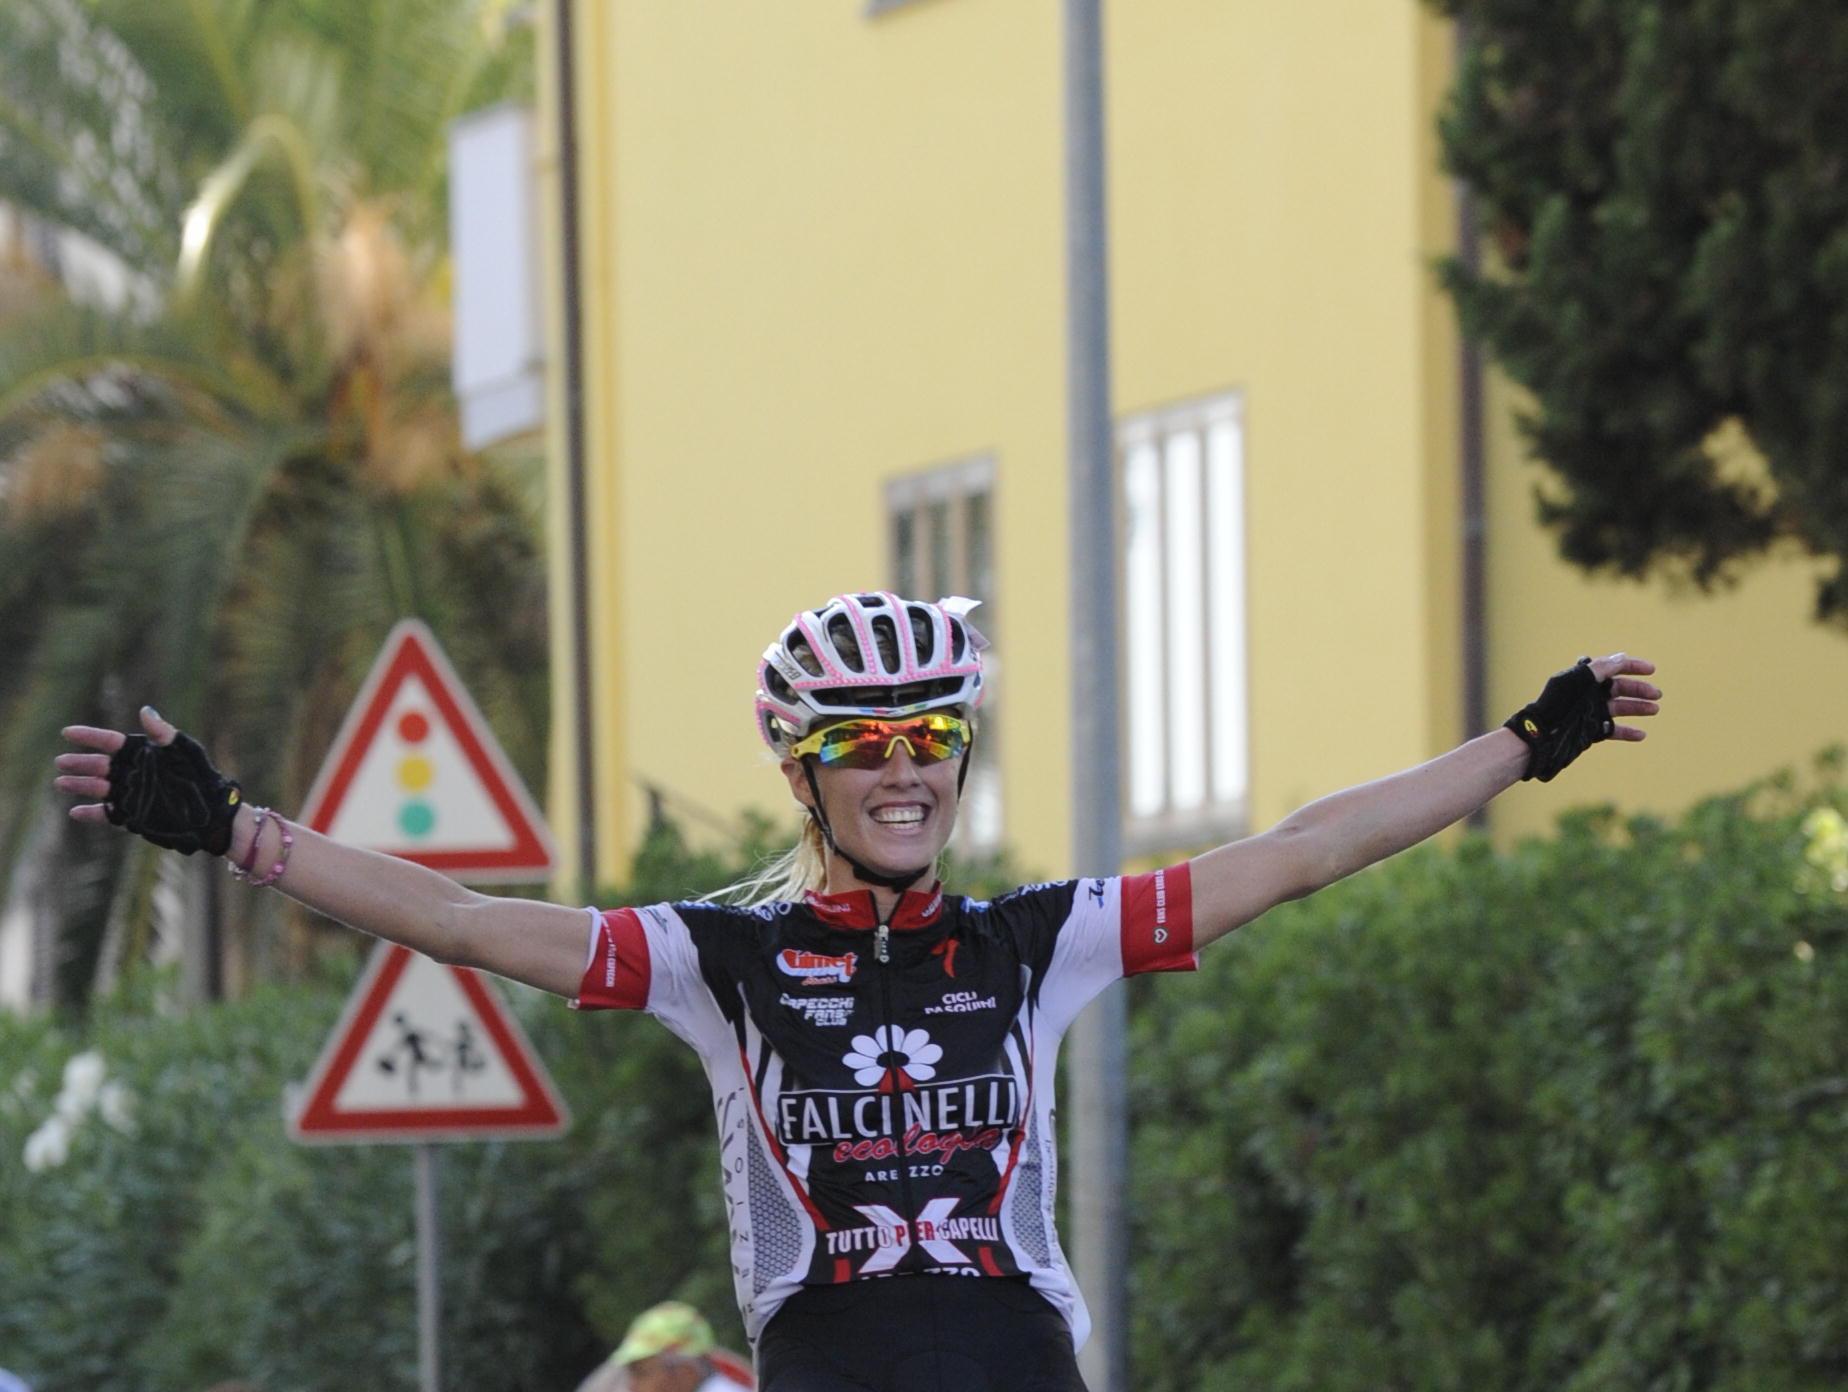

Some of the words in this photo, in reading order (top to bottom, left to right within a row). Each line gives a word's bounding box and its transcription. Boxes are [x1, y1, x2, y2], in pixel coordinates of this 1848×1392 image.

[780, 1081, 1016, 1140] FALCINELLI
[865, 1164, 944, 1182] AREZZO
[826, 1225, 893, 1255] TUTTO
[937, 1217, 999, 1241] CAPELLI
